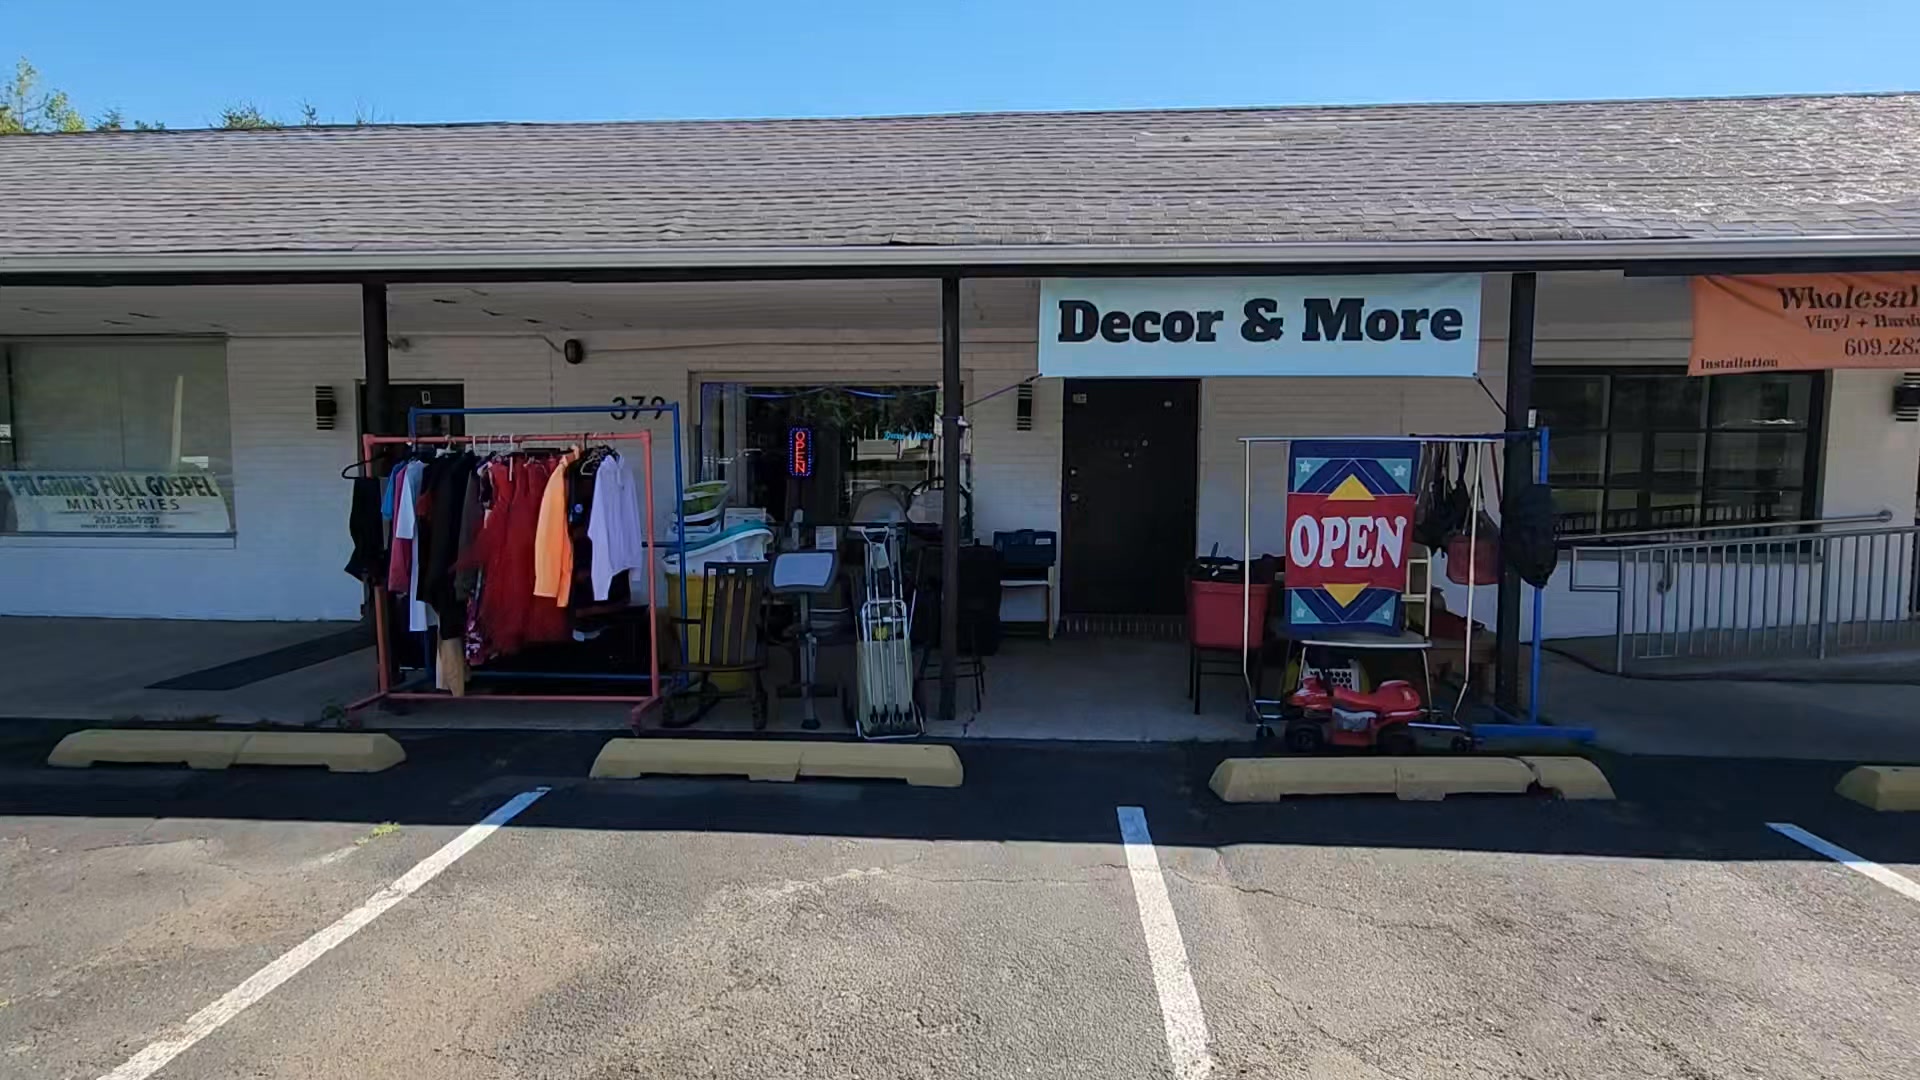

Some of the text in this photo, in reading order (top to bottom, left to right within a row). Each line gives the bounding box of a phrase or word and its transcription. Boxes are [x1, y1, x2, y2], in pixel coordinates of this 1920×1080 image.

[1777, 284, 1918, 310] Wholesal
[1058, 298, 1463, 343] Decor & More
[1805, 314, 1850, 331] Vinyl
[1856, 318, 1869, 329] +
[1700, 356, 1778, 370] Installation
[611, 395, 666, 421] 379
[795, 431, 806, 473] OPEN
[8, 475, 219, 497] PILGRIMS FULL GOSPEL
[66, 497, 181, 511] MINISTRIES
[1290, 514, 1407, 568] OPEN
